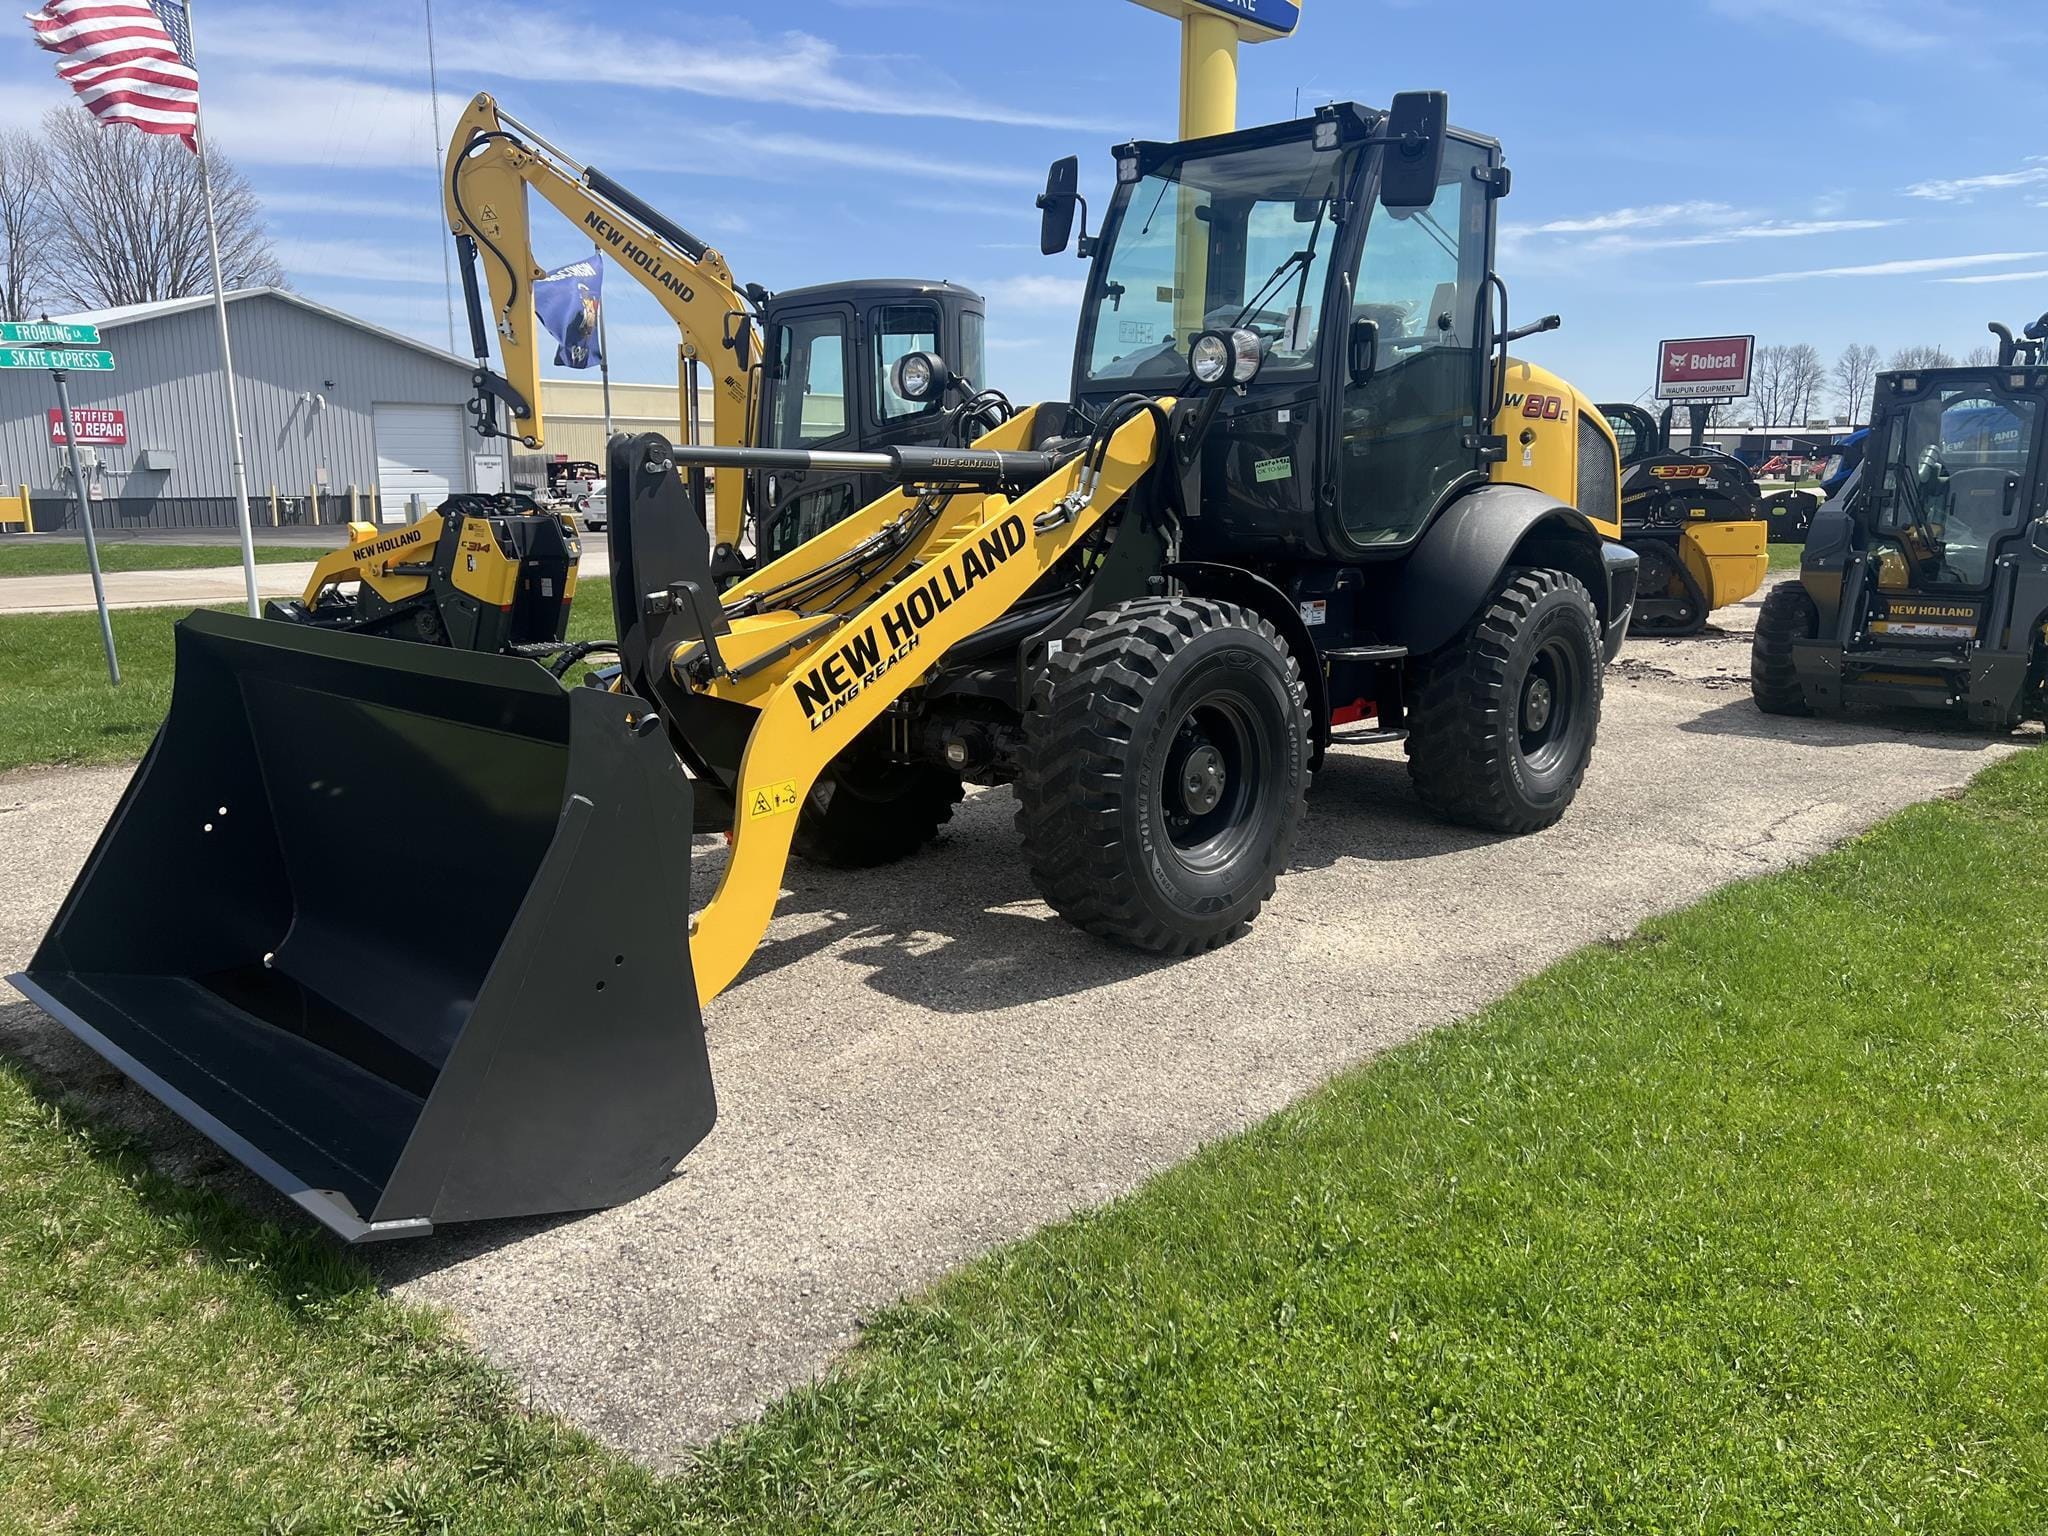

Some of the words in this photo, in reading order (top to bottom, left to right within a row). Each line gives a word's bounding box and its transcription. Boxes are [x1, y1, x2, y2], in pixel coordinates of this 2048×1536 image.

[584, 211, 625, 247] NEW
[622, 241, 695, 303] HOLLAND
[15, 325, 72, 341] FROHLING
[72, 330, 82, 338] LA
[11, 351, 49, 366] SKATE
[51, 352, 100, 368] EXPRESS
[1690, 353, 1737, 370] Bobcat
[1665, 386, 1694, 394] WAUPUN
[1695, 384, 1736, 393] EQUIPMENT
[70, 411, 114, 422] ERTIFIED
[85, 422, 124, 437] REPAIR
[932, 457, 956, 468] RIDE
[957, 458, 1000, 469] CONTROL
[353, 545, 376, 562] NEW
[376, 530, 421, 554] HOLLAND
[793, 625, 882, 719] NEW
[880, 514, 1026, 650] HOLLAND
[1889, 605, 1917, 615] NEW
[1918, 606, 1974, 617] HOLLAND
[809, 683, 860, 732] LONG
[863, 633, 920, 690] REACH
